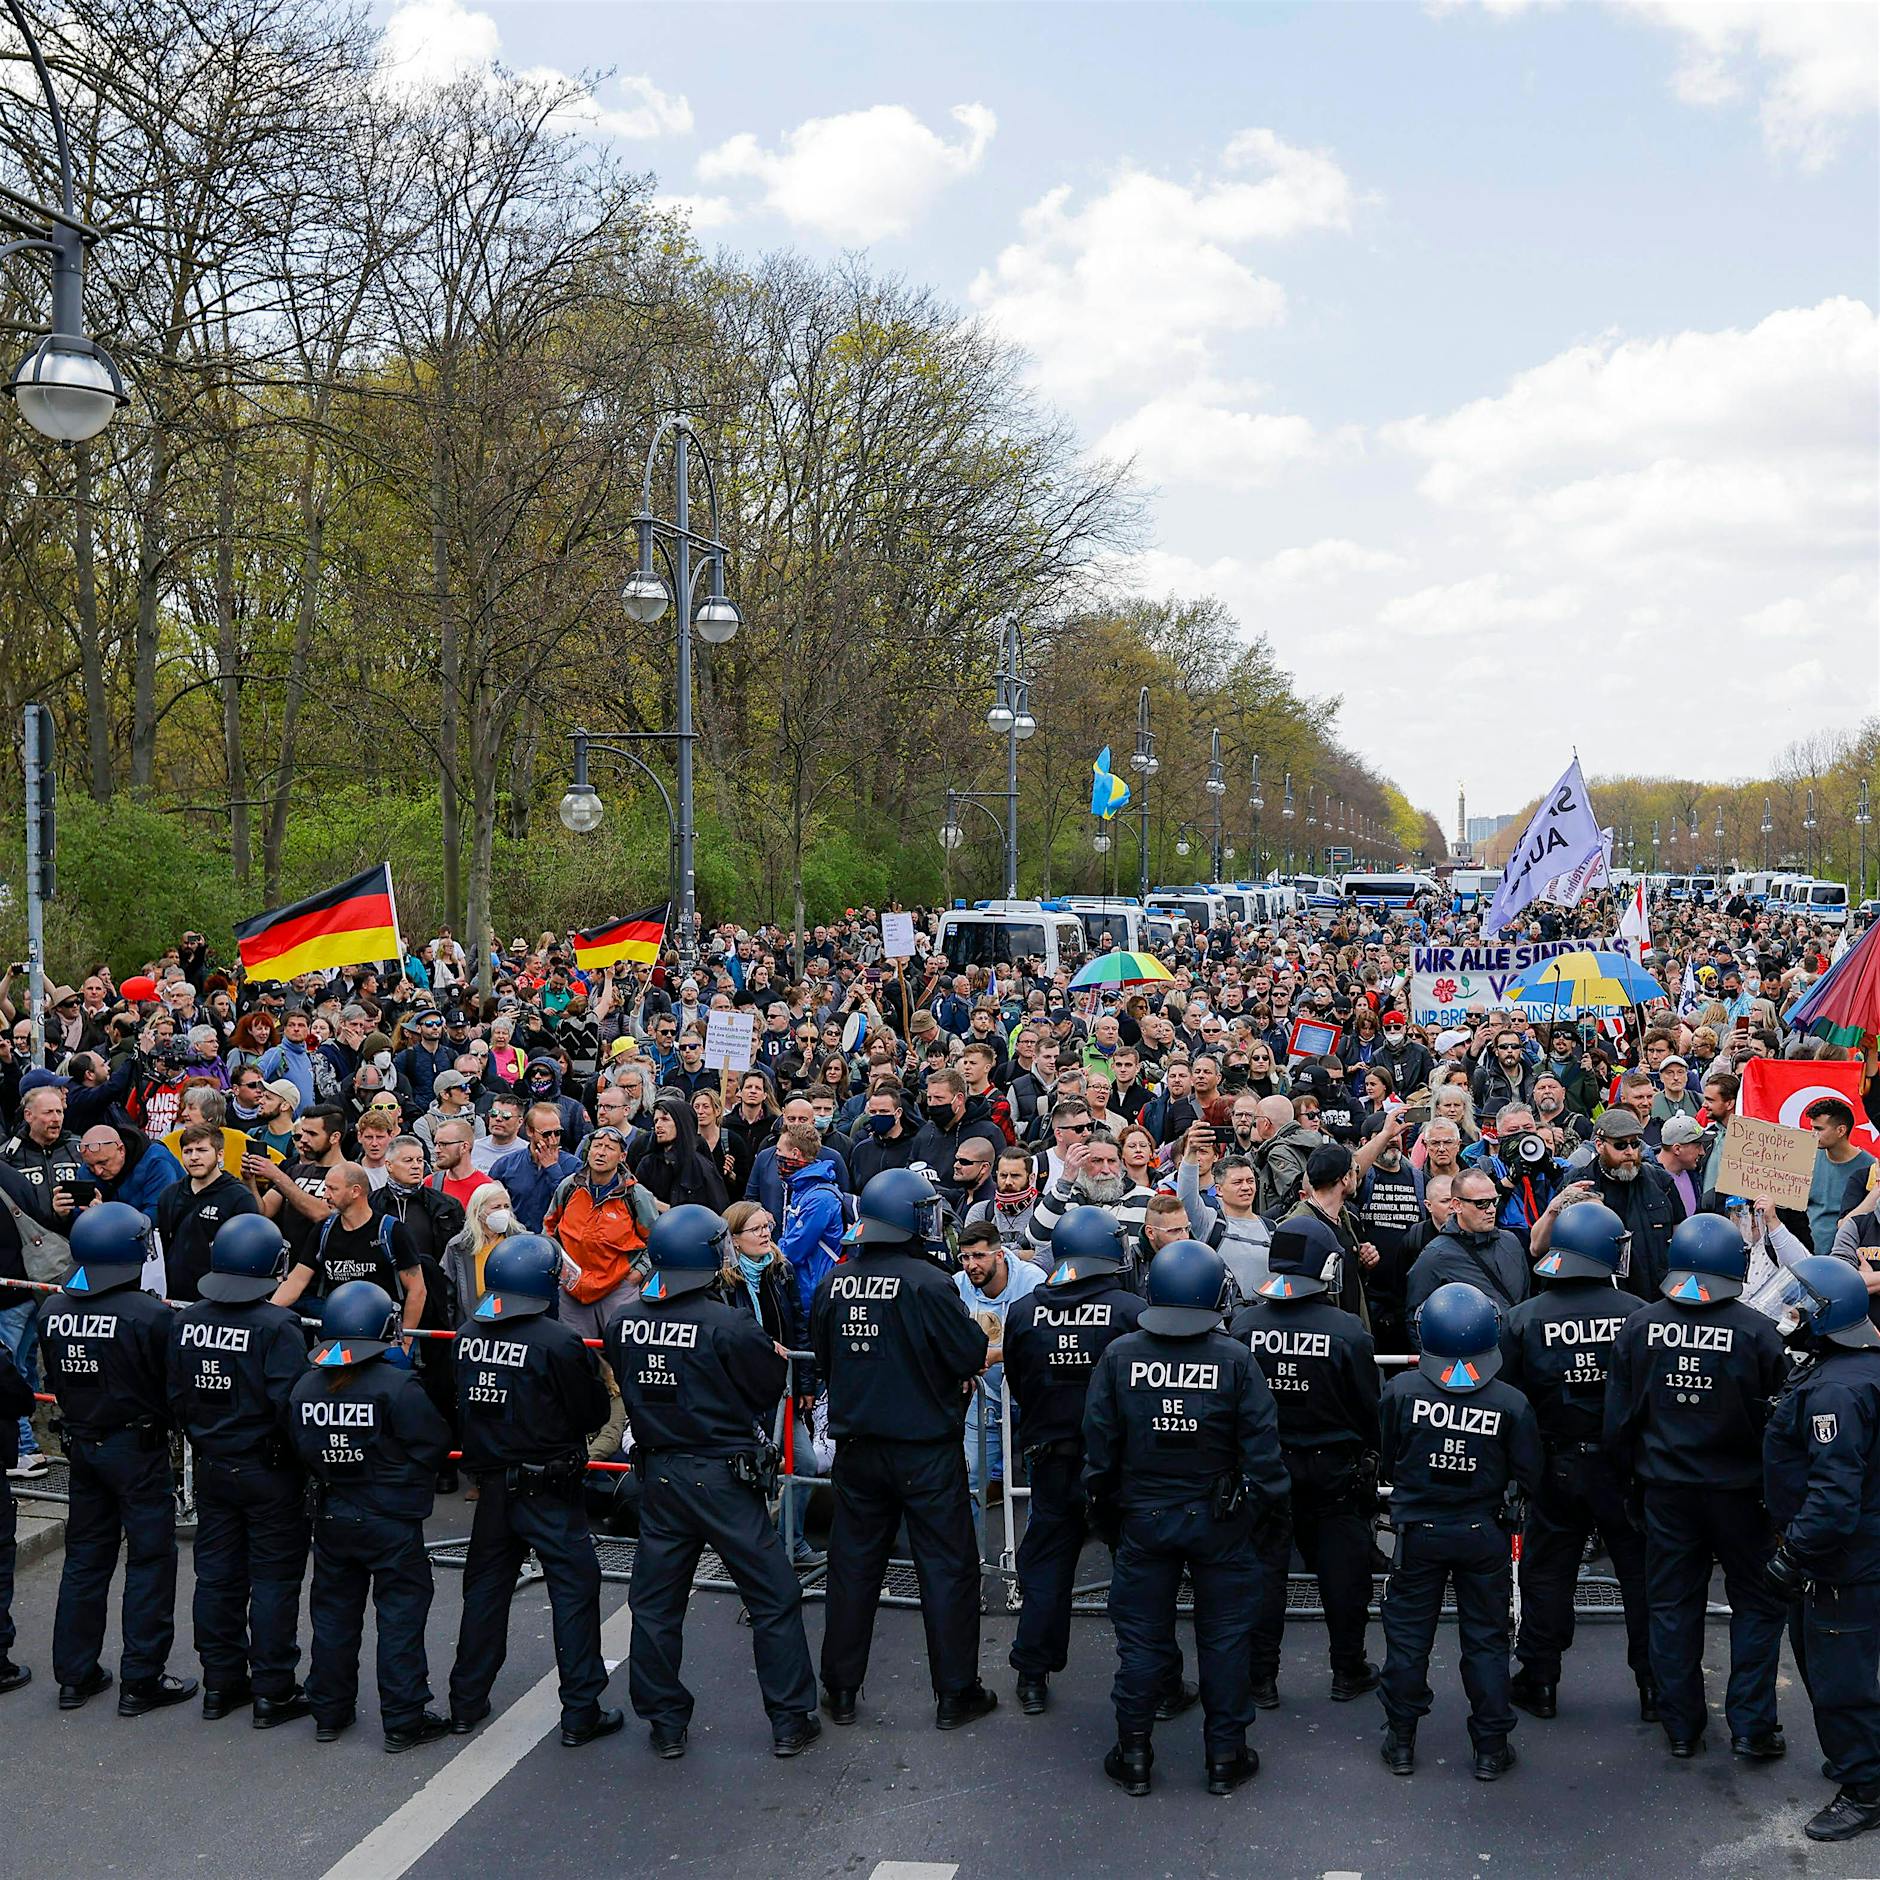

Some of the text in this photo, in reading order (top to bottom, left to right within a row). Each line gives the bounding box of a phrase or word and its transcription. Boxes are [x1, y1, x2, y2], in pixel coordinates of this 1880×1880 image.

[1414, 948, 1454, 973] WIR
[1459, 947, 1510, 971] ALLE
[1415, 1009, 1437, 1027] WIR
[1558, 1004, 1571, 1020] &
[1731, 1121, 1755, 1141] Die
[1741, 1142, 1789, 1163] Gefahr
[1727, 1155, 1743, 1170] ist
[55, 1168, 76, 1182] 38
[1373, 1212, 1392, 1221] BEIDES
[334, 1260, 377, 1273] ZENSUR
[830, 1276, 900, 1300] POLIZEI
[850, 1306, 867, 1321] BE
[1032, 1303, 1112, 1327] POLIZEI
[46, 1314, 117, 1339] POLIZEI
[620, 1319, 698, 1349] POLIZEI
[841, 1323, 879, 1337] 13210
[180, 1324, 250, 1352] POLIZEI
[1058, 1334, 1078, 1349] BE
[1250, 1329, 1331, 1358] POLIZEI
[1647, 1322, 1734, 1353] POLIZEI
[67, 1344, 86, 1358] BE
[458, 1337, 528, 1368] POLIZEI
[1048, 1351, 1092, 1365] 13211
[60, 1359, 99, 1373] 13228
[202, 1359, 220, 1374] BE
[647, 1353, 666, 1369] BE
[1575, 1352, 1597, 1368] BE
[1678, 1356, 1700, 1373] BE
[637, 1370, 678, 1386] 13221
[1129, 1361, 1220, 1390] POLIZEI
[1277, 1362, 1297, 1377] BE
[194, 1374, 232, 1390] 13229
[478, 1371, 497, 1387] BE
[1266, 1377, 1310, 1392] 13216
[1665, 1373, 1713, 1390] 13212
[468, 1386, 507, 1404] 13227
[301, 1401, 375, 1428] POLIZEI
[1161, 1399, 1184, 1416] BE
[1152, 1416, 1198, 1433] 13219
[1412, 1399, 1501, 1436] POLIZEI
[329, 1433, 350, 1448] BE
[1443, 1438, 1466, 1455] BE
[321, 1449, 364, 1463] 13226
[1428, 1452, 1477, 1473] 13215
